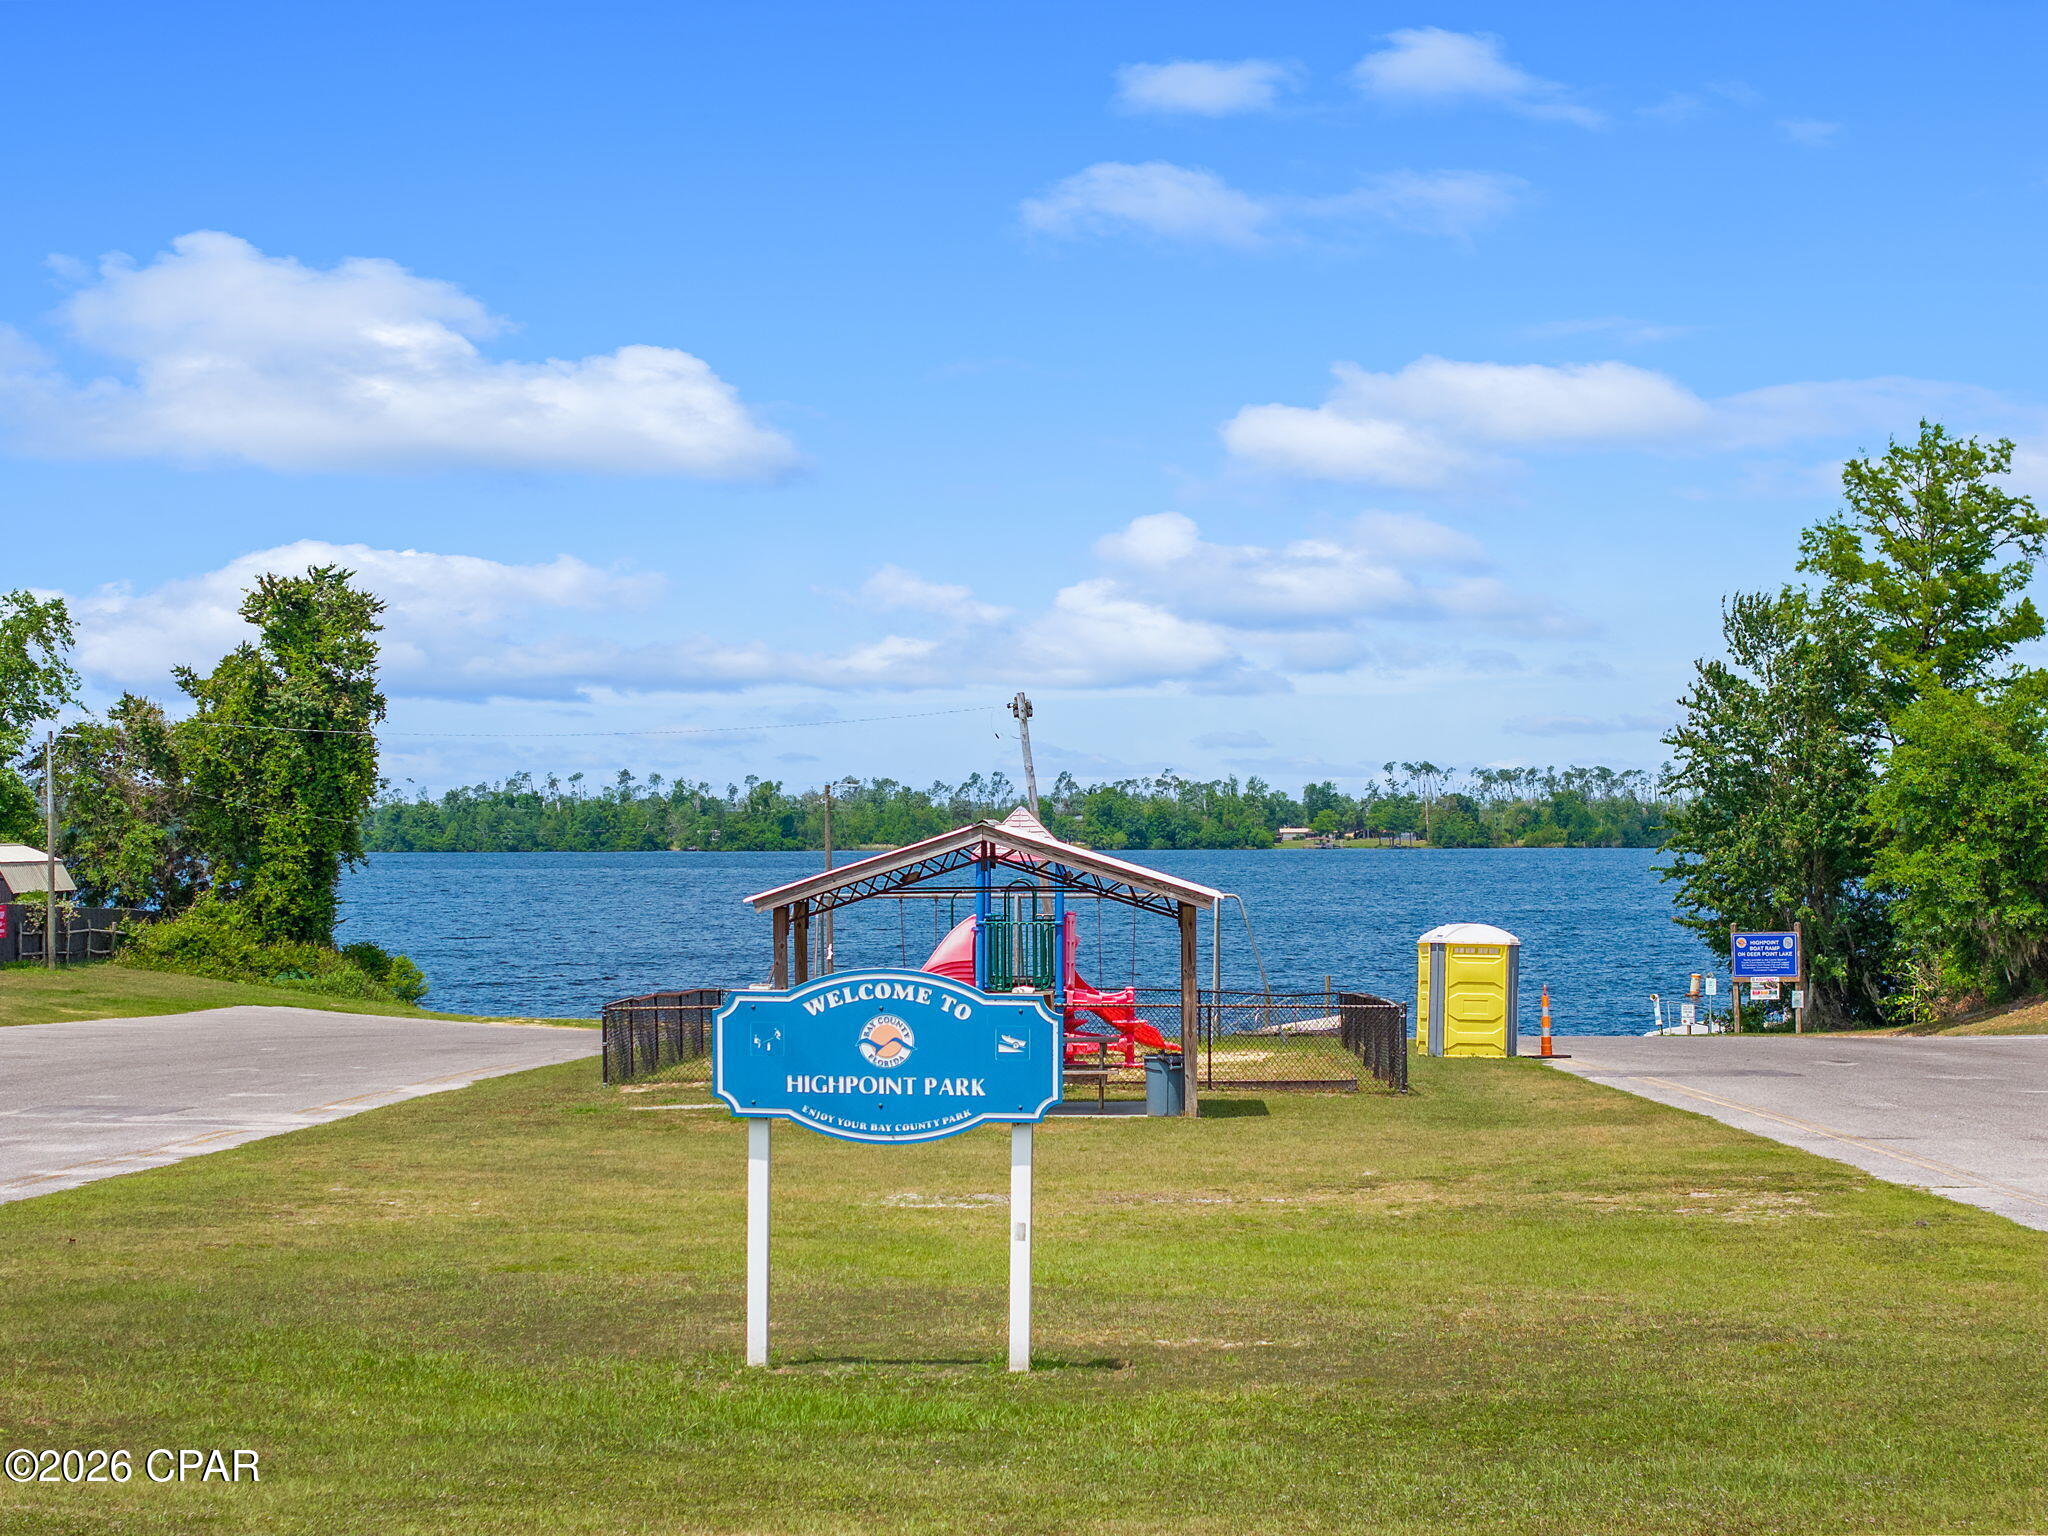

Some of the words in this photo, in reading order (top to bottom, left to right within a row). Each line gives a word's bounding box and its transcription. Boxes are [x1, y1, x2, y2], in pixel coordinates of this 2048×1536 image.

[802, 982, 932, 1016] WELCOME
[940, 994, 972, 1020] TO
[863, 1020, 876, 1037] BAY
[877, 1016, 910, 1038] COUNTY
[868, 1053, 904, 1067] FLORIDA
[786, 1074, 917, 1095] HIGHPOINT
[923, 1077, 986, 1097] PARK
[801, 1104, 836, 1124] ENJOY
[837, 1117, 867, 1130] YOUR
[870, 1123, 892, 1132] BAY
[894, 1120, 940, 1132] COUNTY
[942, 1109, 972, 1124] PARK
